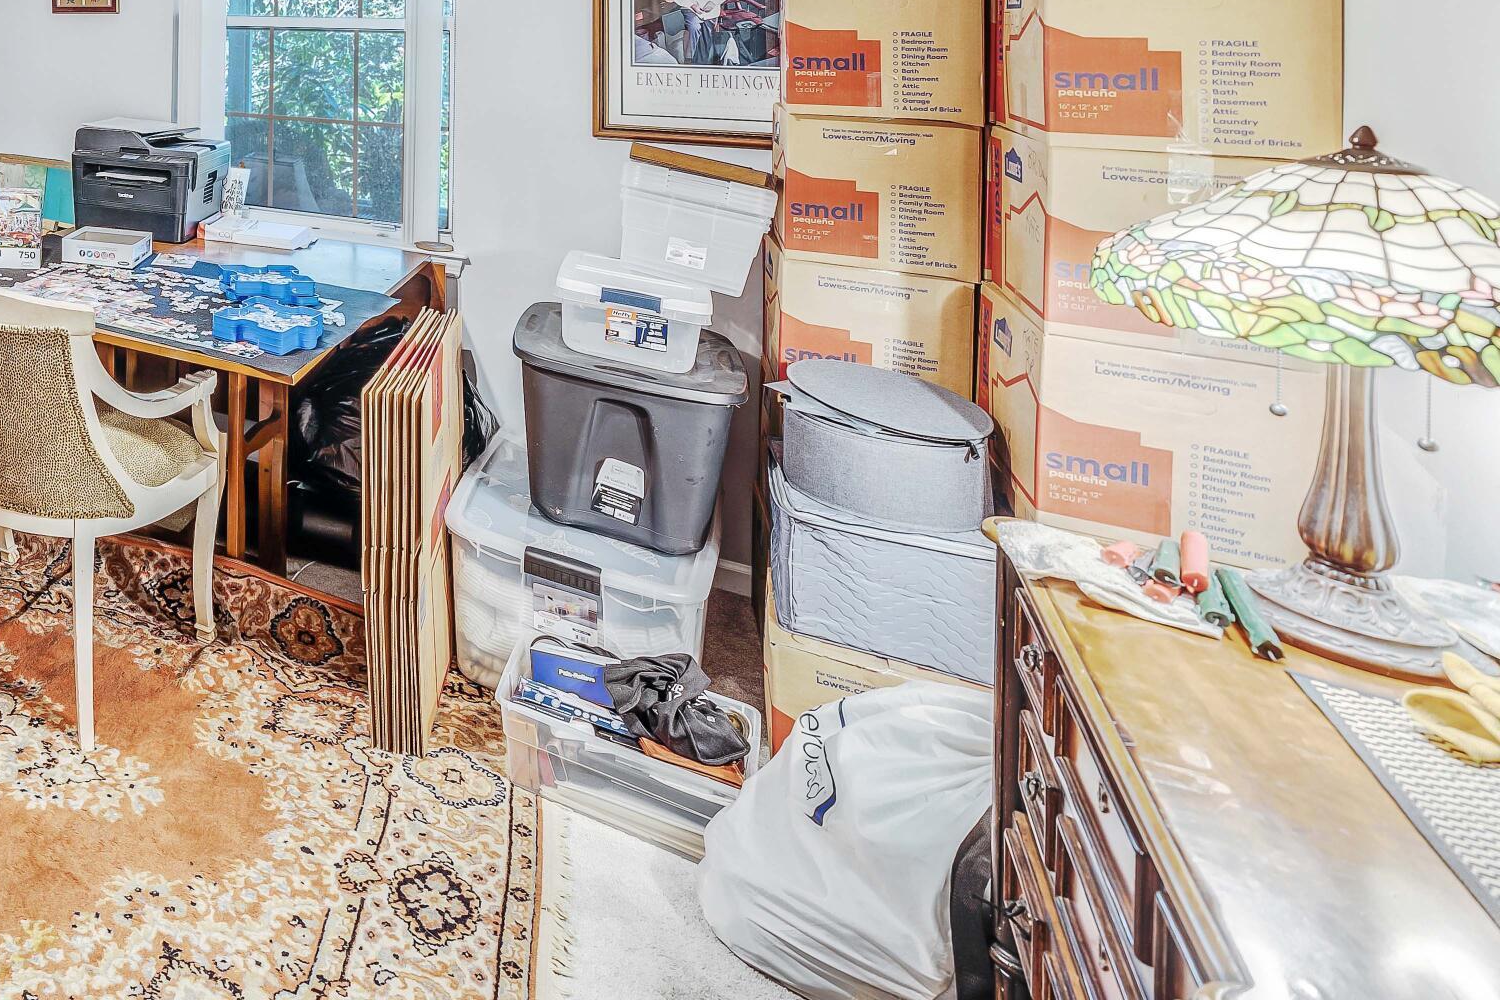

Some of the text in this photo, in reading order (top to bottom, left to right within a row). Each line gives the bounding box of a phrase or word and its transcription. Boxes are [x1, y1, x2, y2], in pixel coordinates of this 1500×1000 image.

[792, 52, 865, 71] small
[636, 72, 692, 87] ERNEST
[1054, 68, 1159, 91] small
[1058, 88, 1117, 98] pequeña
[822, 133, 916, 145] Lowes.com/Moving
[790, 202, 863, 222] small
[792, 216, 834, 226] pequeña
[18, 251, 36, 259] 750
[818, 280, 910, 300] Lowes.com/Moving
[613, 310, 630, 318] Hefty
[1094, 366, 1230, 396] Lowes.com/Moving
[1045, 452, 1149, 487] small
[1048, 471, 1108, 487] pequeña
